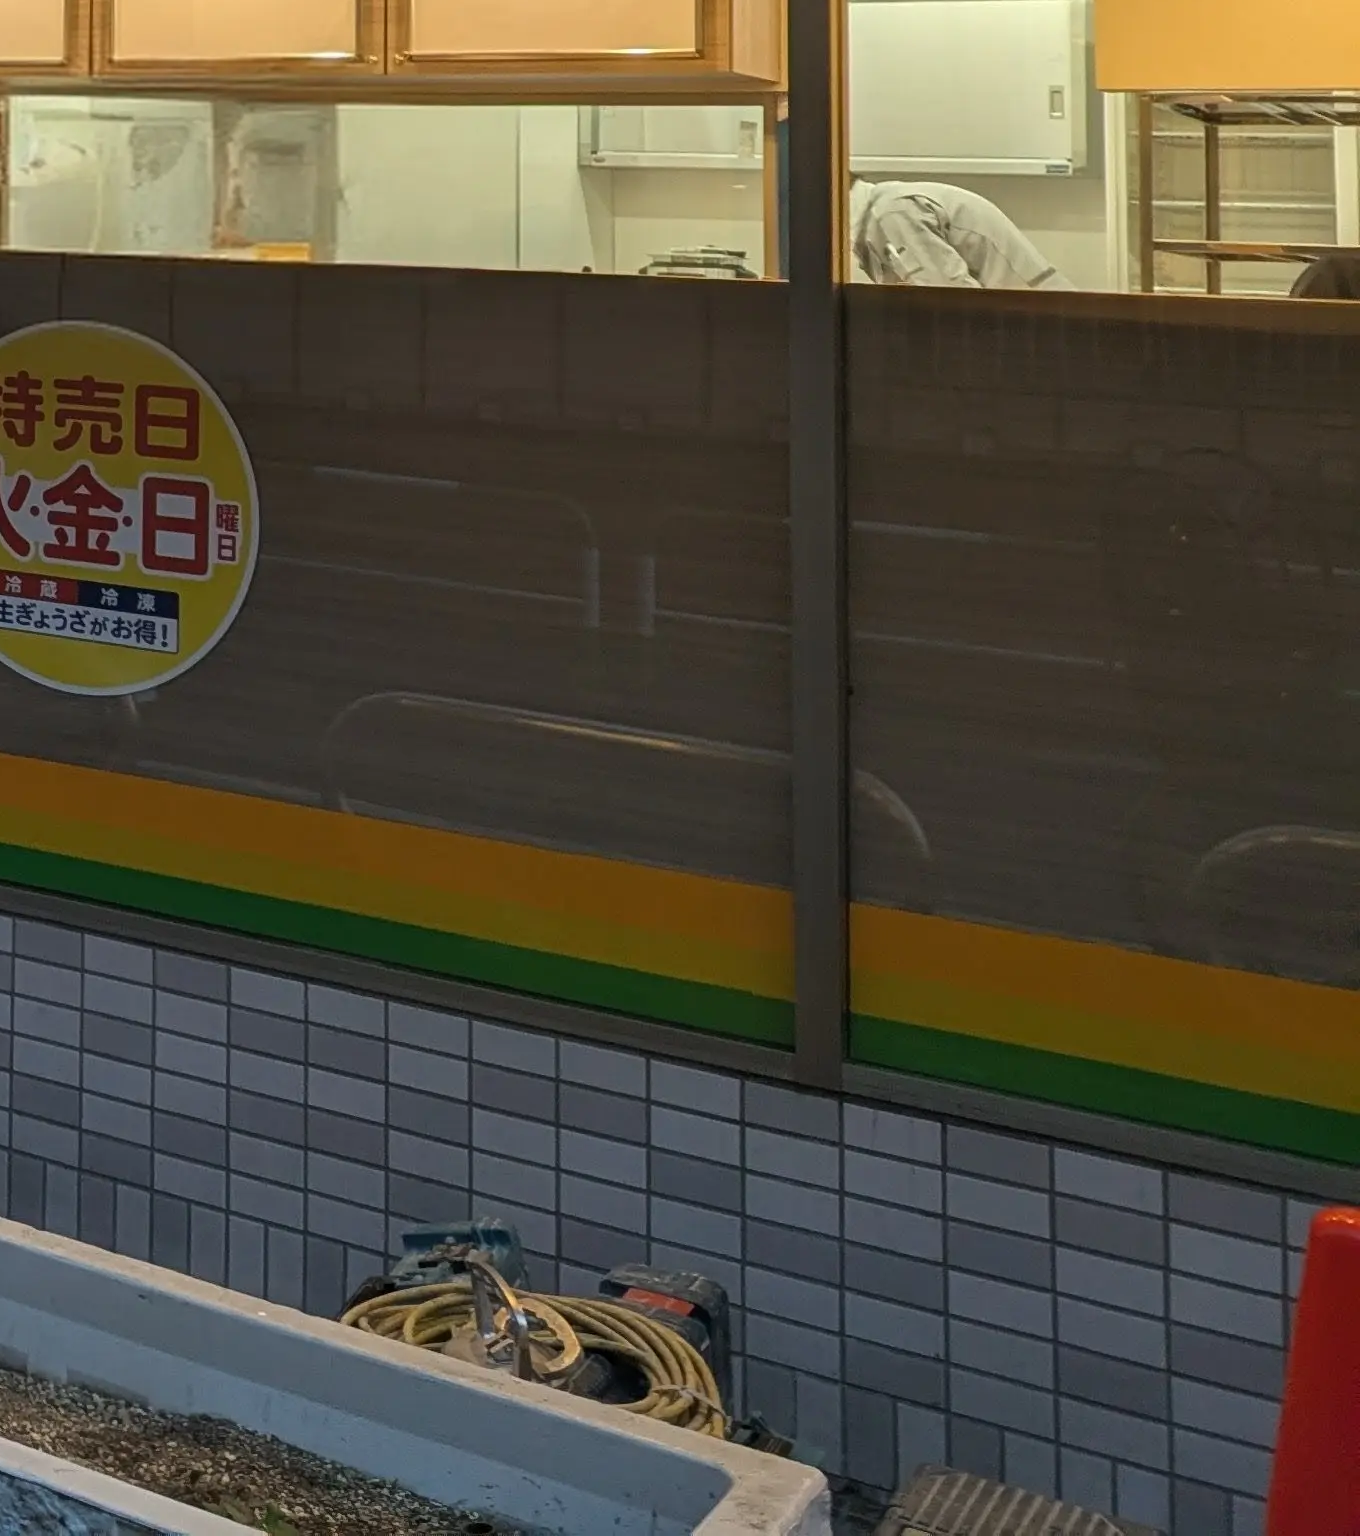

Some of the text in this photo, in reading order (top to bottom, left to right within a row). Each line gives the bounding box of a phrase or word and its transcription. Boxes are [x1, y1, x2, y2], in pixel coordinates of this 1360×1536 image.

[216, 504, 240, 563] 曜日
[4, 574, 157, 613] 冷蔵 冷凍
